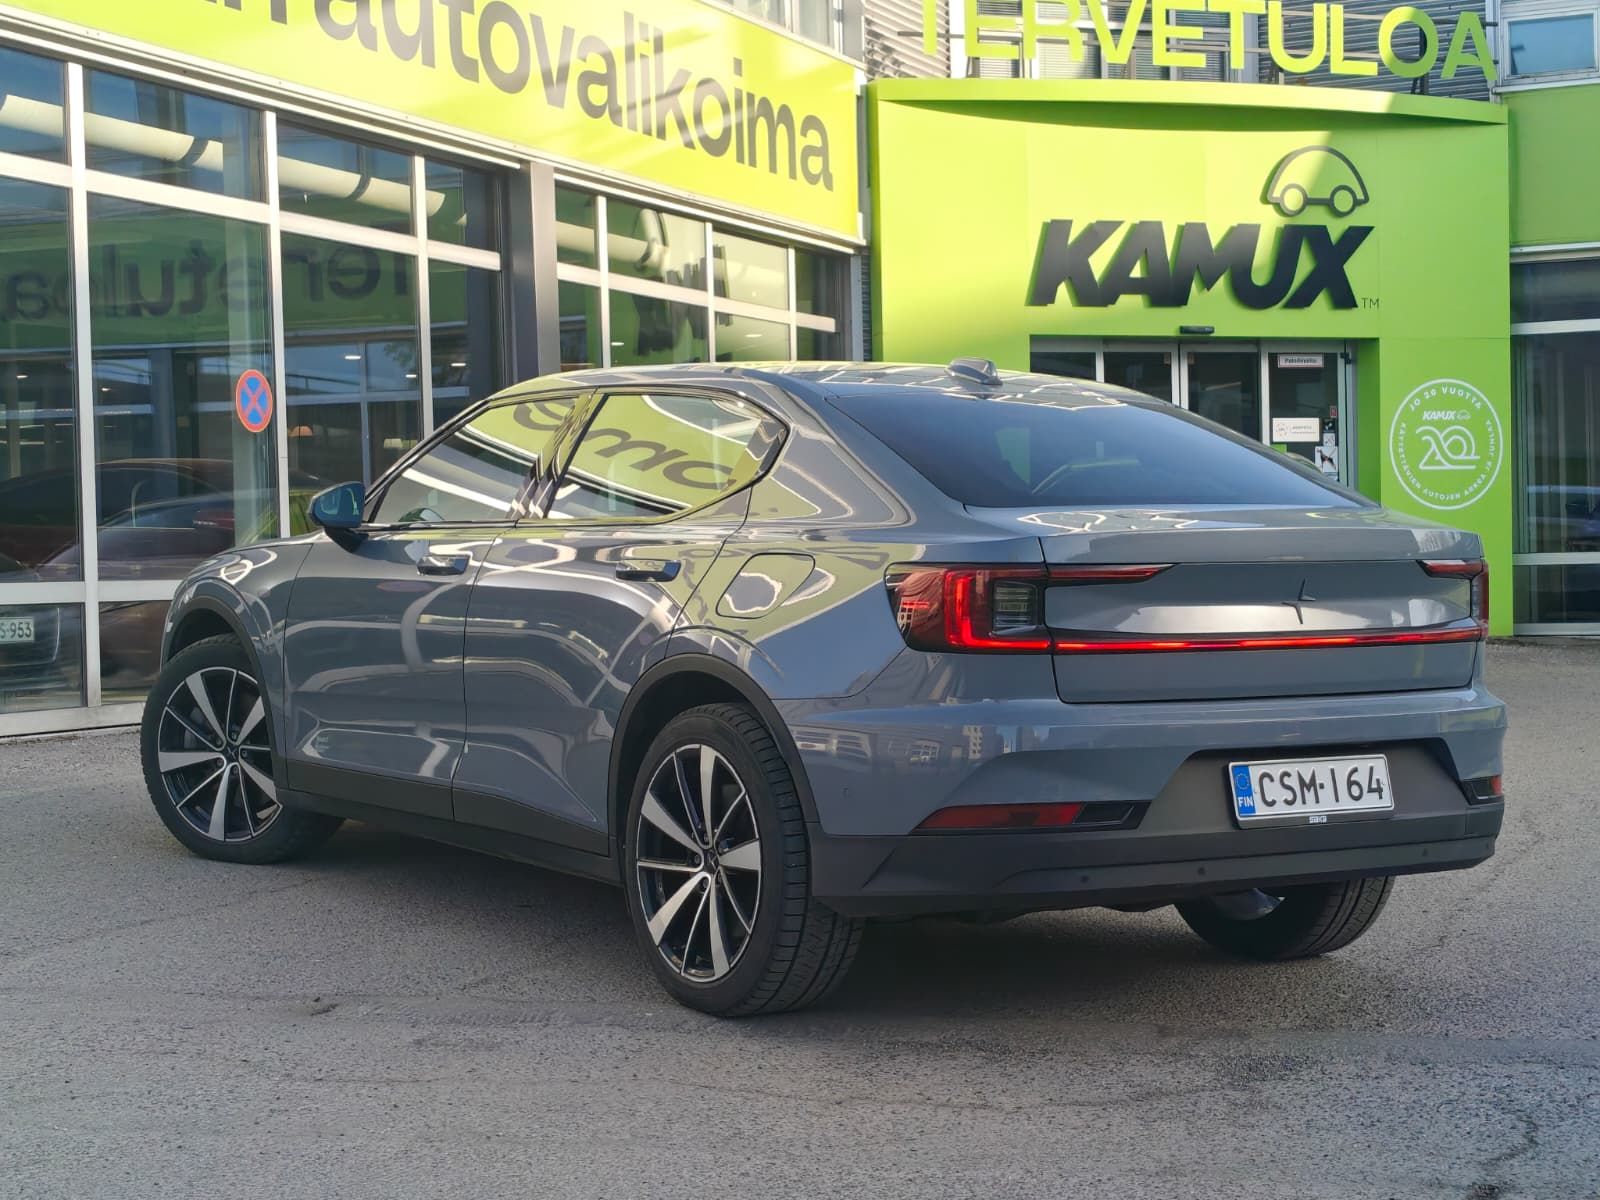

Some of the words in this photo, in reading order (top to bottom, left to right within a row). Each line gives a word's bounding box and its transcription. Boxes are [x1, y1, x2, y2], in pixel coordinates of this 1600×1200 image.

[922, 0, 1498, 81] TERVETULOA
[1028, 219, 1375, 309] KAMUX
[1441, 385, 1482, 409] VUOTTA
[1422, 410, 1456, 421] KAMUX
[1238, 796, 1254, 809] FIN
[1259, 765, 1383, 807] CSM-164
